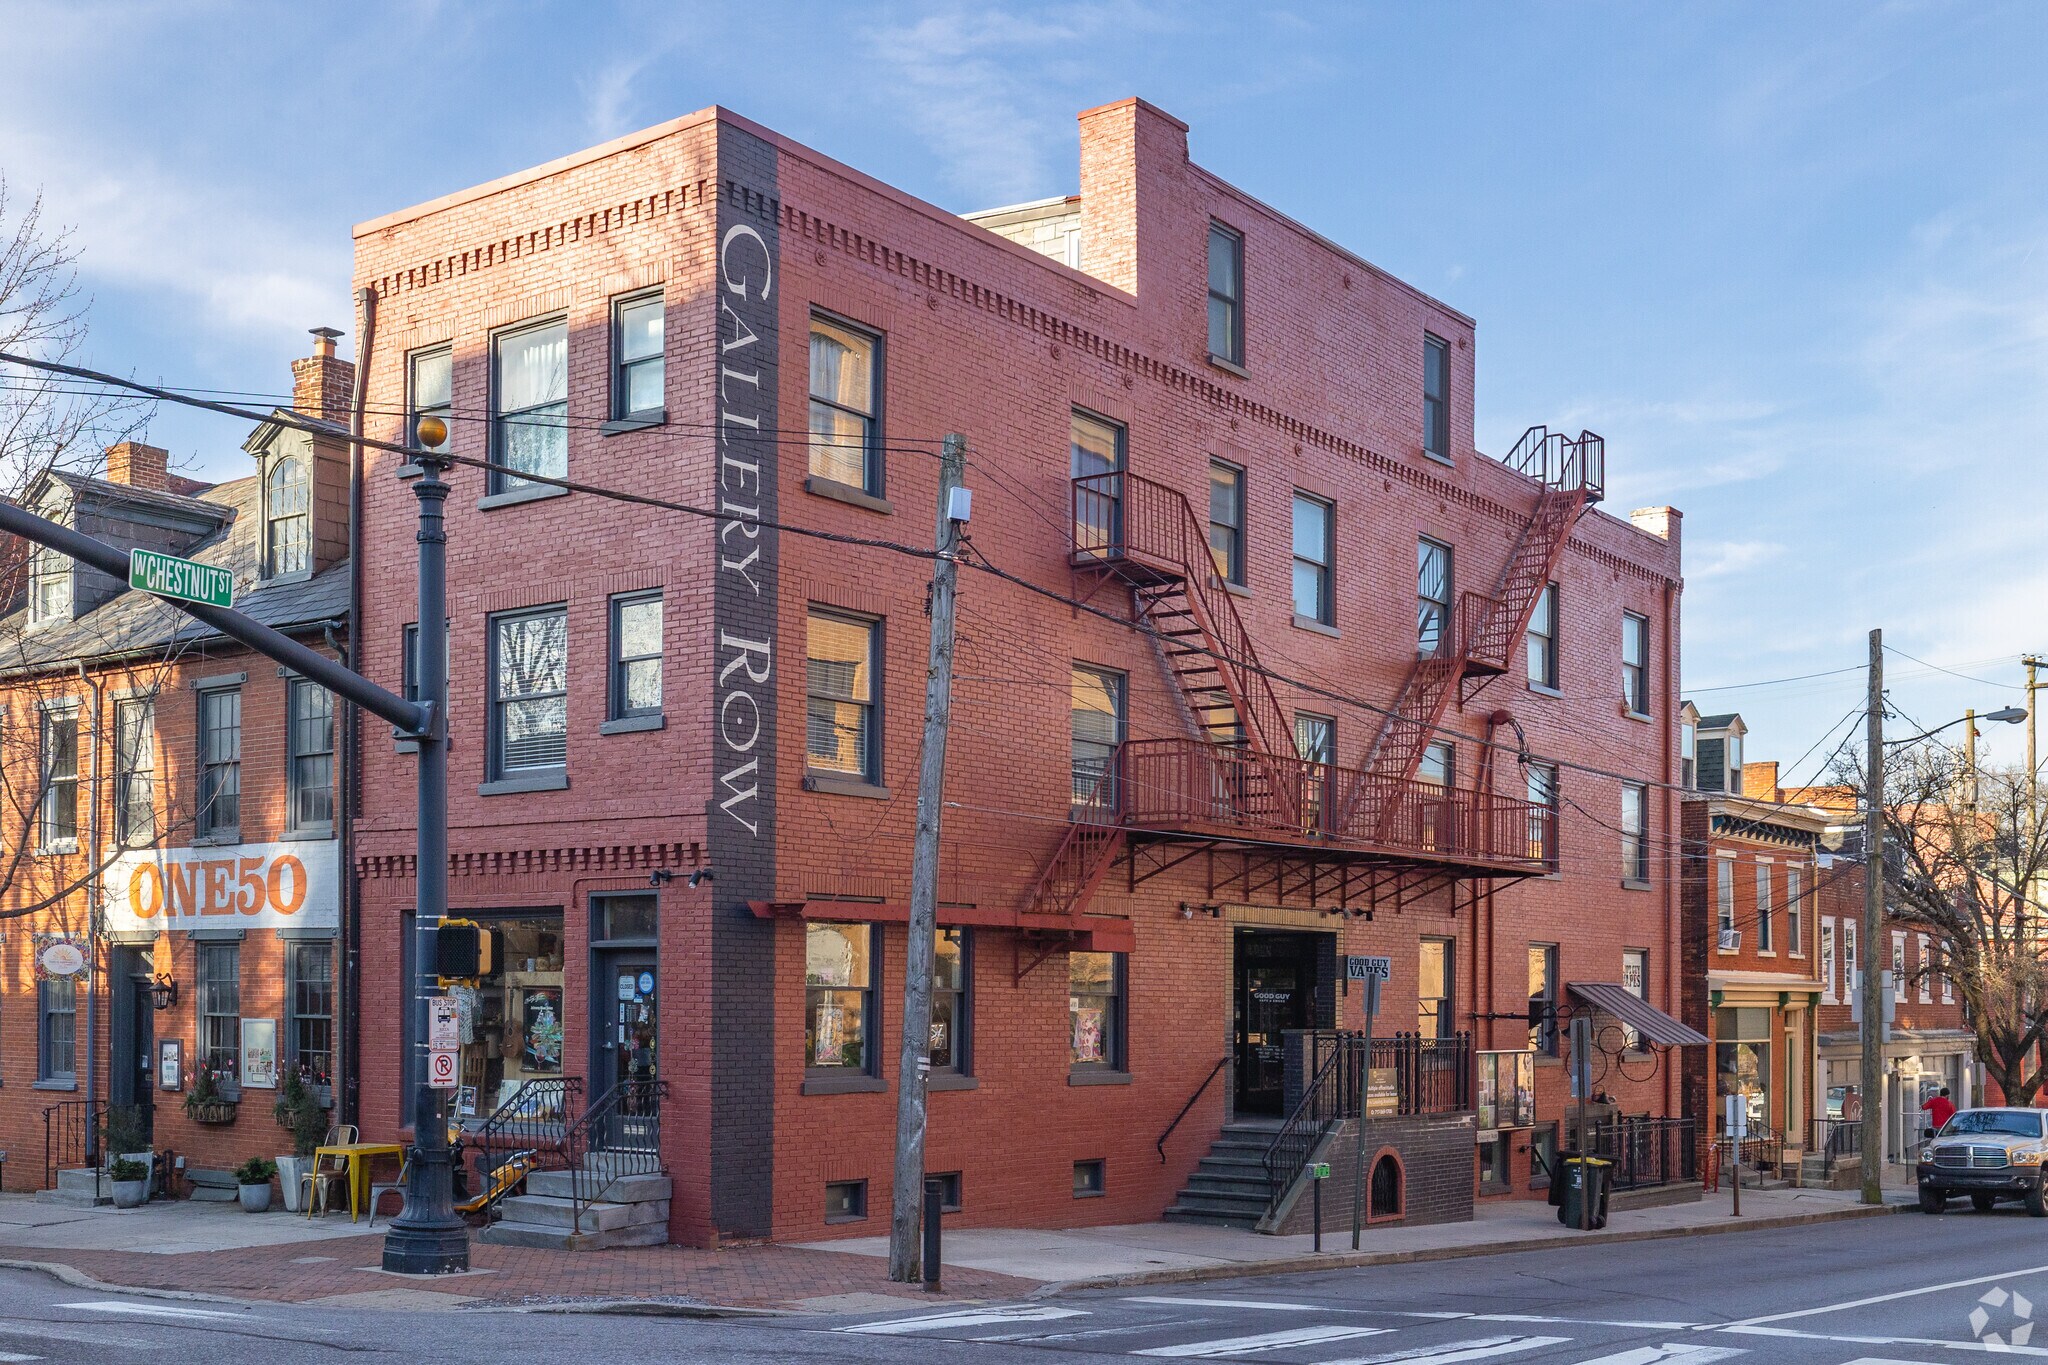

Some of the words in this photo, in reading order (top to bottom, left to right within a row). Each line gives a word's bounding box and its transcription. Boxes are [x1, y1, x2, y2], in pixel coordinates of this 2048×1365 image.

[721, 224, 771, 596] GALLERY
[134, 553, 147, 576] W
[146, 555, 218, 600] CHESTNUT
[218, 571, 231, 594] ST
[720, 628, 771, 837] ROW
[129, 854, 307, 919] ONE50
[1349, 957, 1370, 966] GOOD
[1371, 958, 1388, 967] GUY
